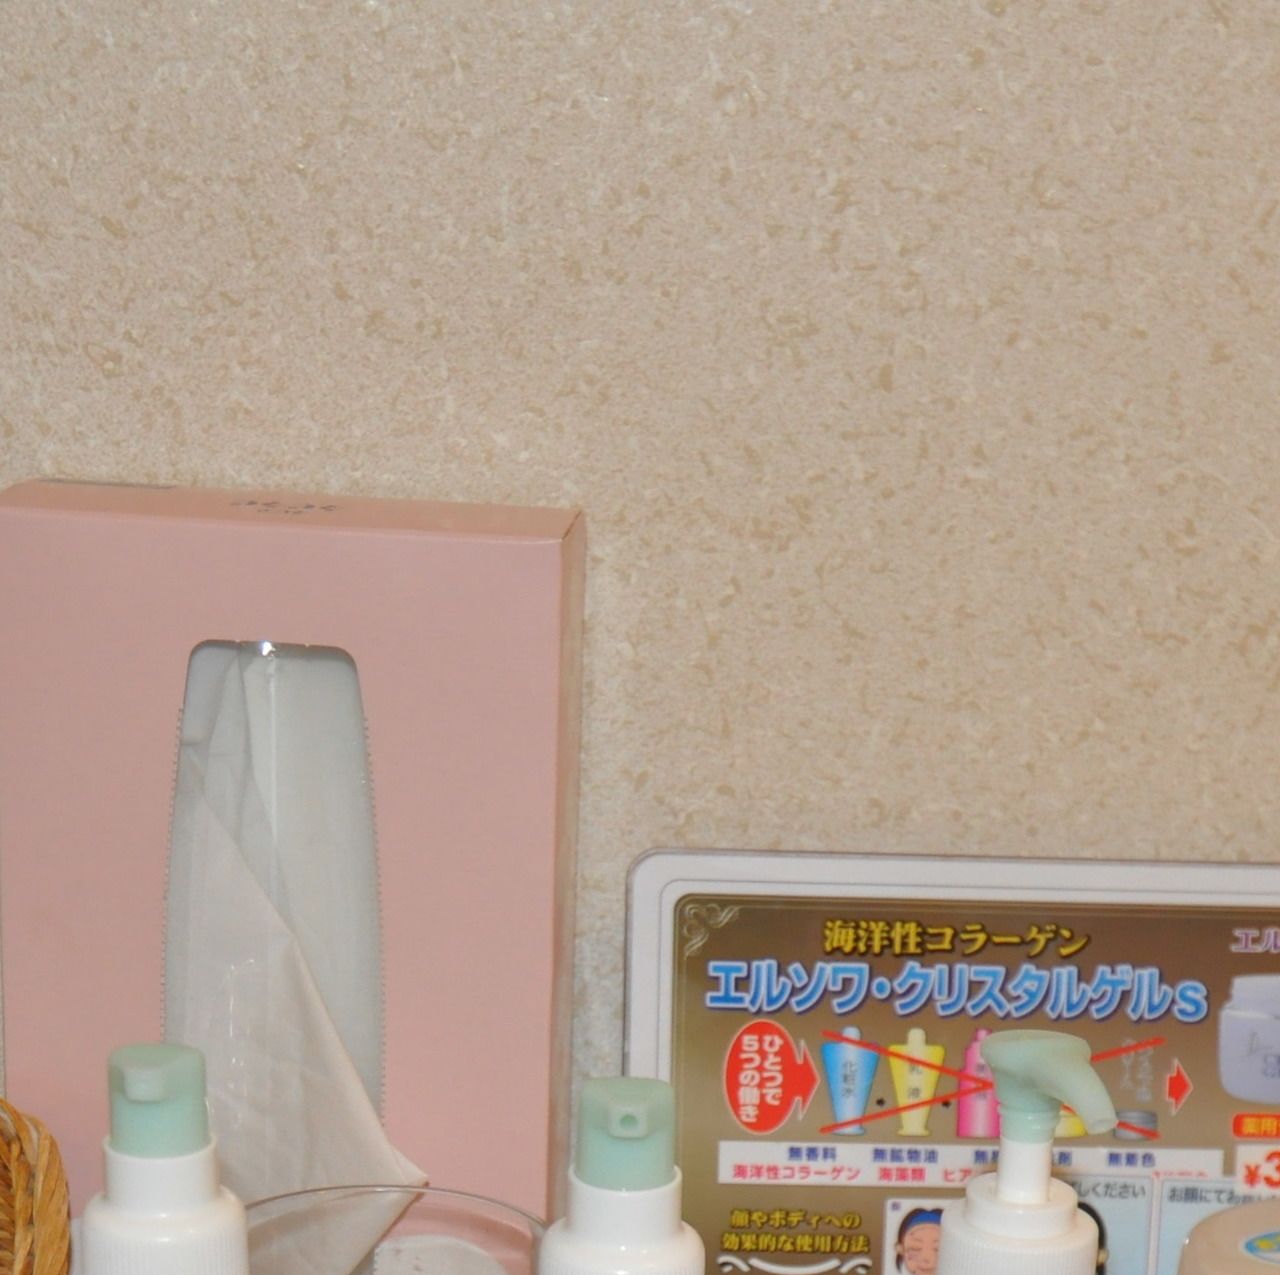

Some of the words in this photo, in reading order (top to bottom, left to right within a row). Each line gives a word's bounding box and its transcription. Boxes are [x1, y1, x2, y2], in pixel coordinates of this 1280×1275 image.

[823, 920, 1090, 957] 海洋性コラーゲン
[762, 1033, 784, 1106] ひとつで
[733, 1164, 860, 1181] 海洋性コラーゲン
[1074, 1180, 1147, 1199] しください
[722, 1233, 870, 1254] 効果的な使用方法
